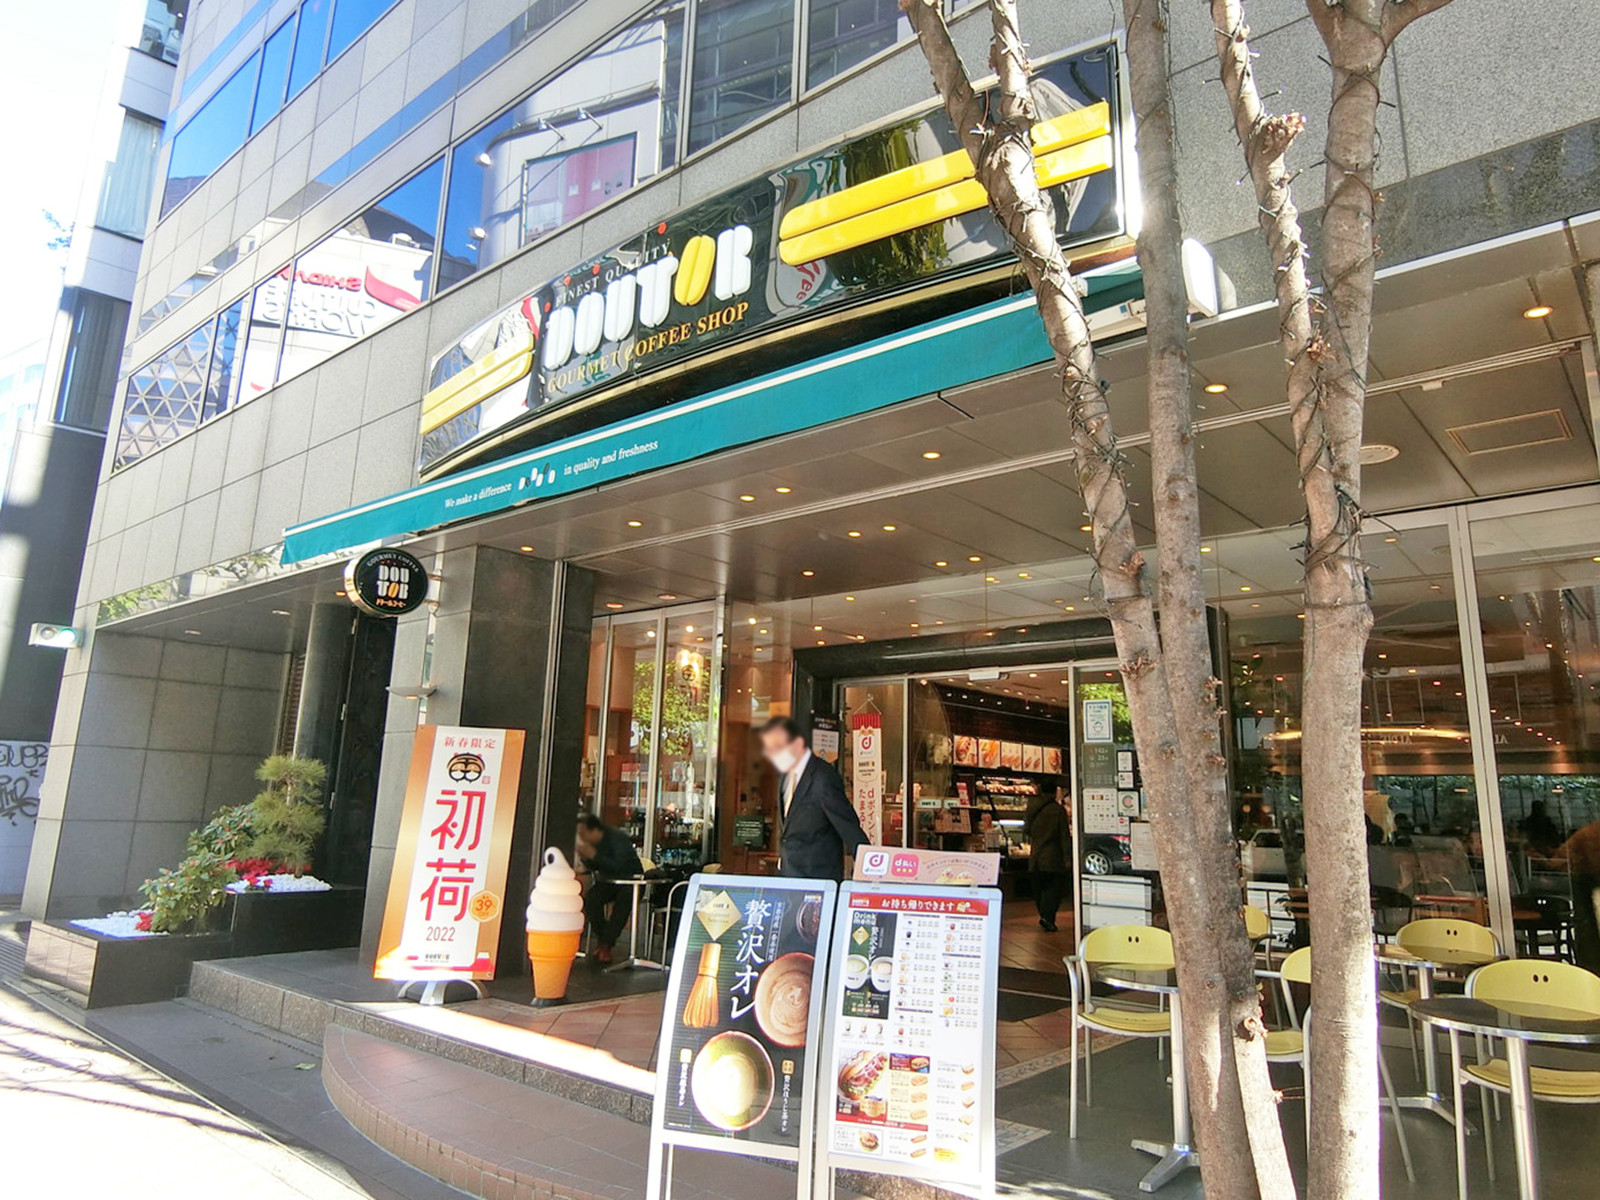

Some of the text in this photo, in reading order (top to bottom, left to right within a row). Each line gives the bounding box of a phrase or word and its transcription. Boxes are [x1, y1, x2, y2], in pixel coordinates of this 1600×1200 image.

[555, 237, 672, 308] FINEST QUALITY
[543, 224, 753, 371] DOUTOR
[547, 301, 749, 394] GOURMET COFFEE SHOP
[564, 440, 658, 475] in quality and freshness
[445, 482, 512, 508] We make a difference
[445, 736, 496, 750] 新春限定
[420, 789, 488, 922] 初荷
[853, 918, 877, 926] menu
[881, 898, 955, 911] お持ち帰りできます
[426, 926, 456, 942] 2022
[730, 899, 772, 1020] 贅沢オレ
